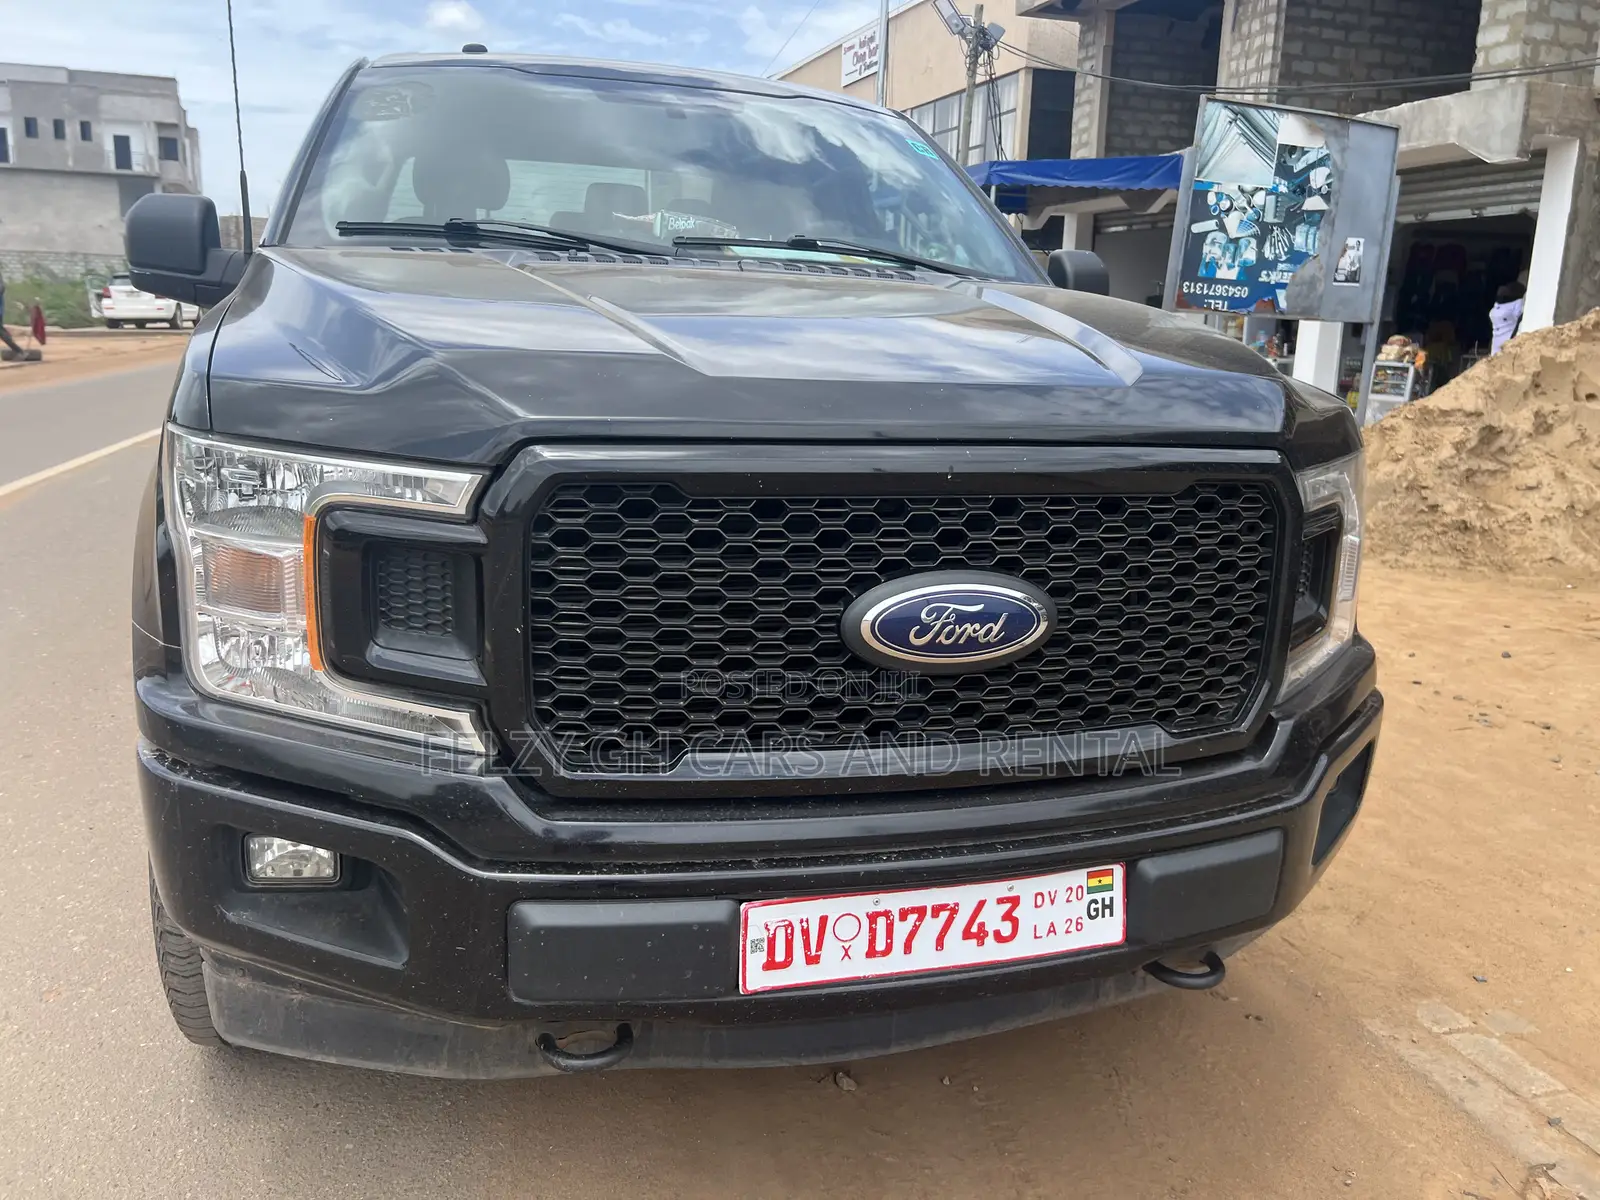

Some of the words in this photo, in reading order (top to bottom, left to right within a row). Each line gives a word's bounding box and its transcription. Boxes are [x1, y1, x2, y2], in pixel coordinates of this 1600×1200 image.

[1182, 281, 1249, 298] 0543671313
[908, 602, 1009, 646] Ford
[1034, 889, 1057, 908] DV
[1065, 884, 1084, 903] 20
[1086, 896, 1114, 920] GH
[762, 912, 829, 971] DV
[864, 895, 1021, 959] D7743
[1033, 920, 1057, 939] LA
[1064, 916, 1083, 934] 26
